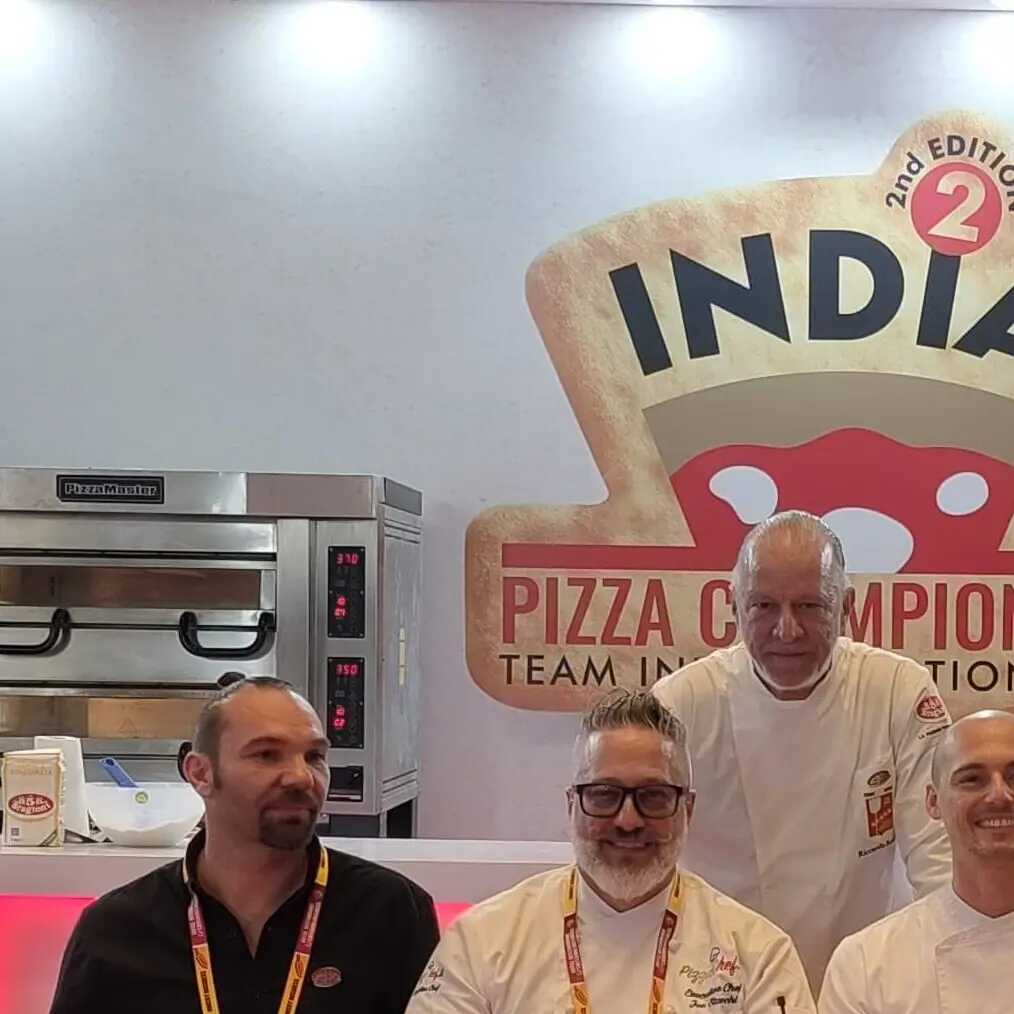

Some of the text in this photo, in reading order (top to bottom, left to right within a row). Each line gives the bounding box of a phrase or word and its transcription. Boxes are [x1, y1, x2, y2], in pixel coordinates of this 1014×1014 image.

[885, 152, 925, 209] 2nd
[928, 170, 986, 243] 2
[64, 482, 157, 496] PizzaMaster
[502, 576, 675, 646] PIZZA
[499, 654, 617, 686] TEAM
